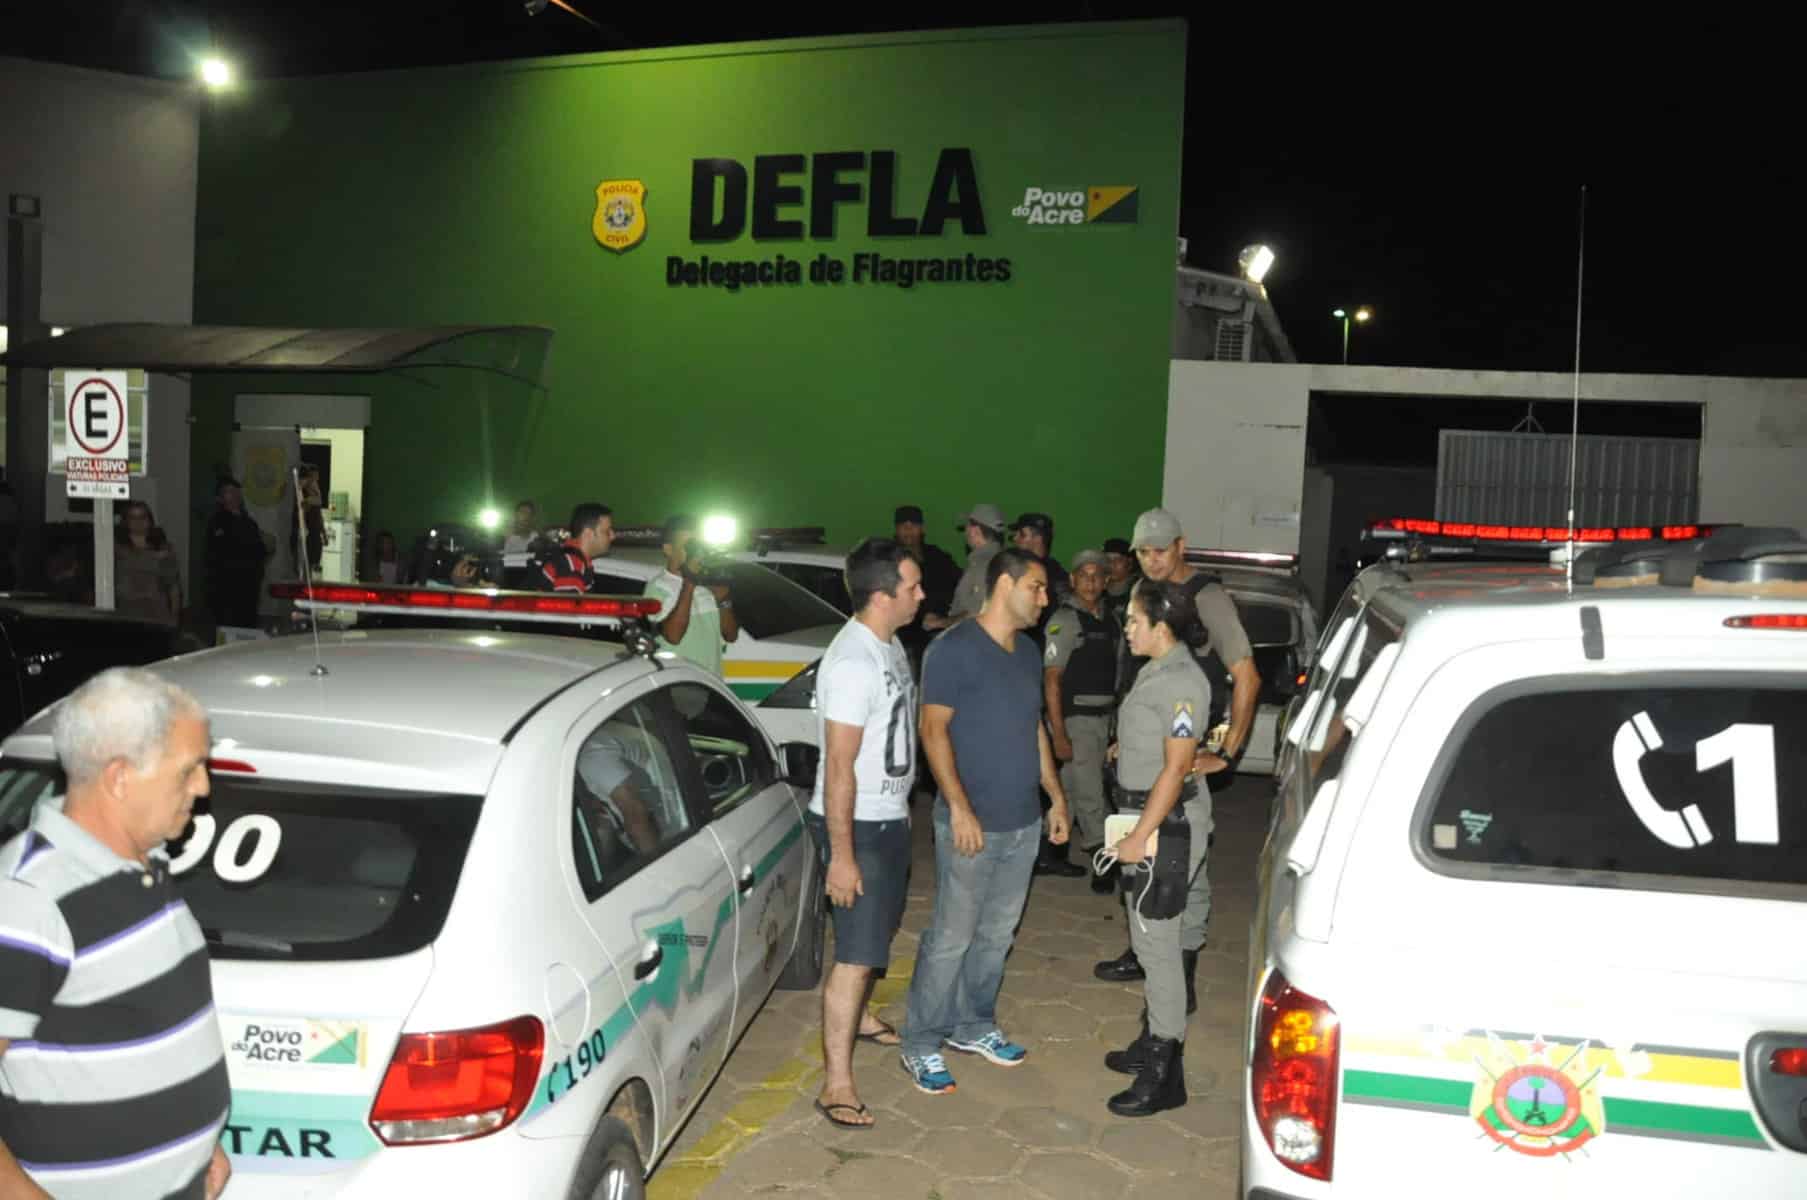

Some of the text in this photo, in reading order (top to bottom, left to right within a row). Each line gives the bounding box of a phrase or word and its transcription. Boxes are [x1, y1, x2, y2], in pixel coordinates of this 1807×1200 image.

[689, 148, 987, 242] DEFLA
[1024, 187, 1085, 208] Povo
[1012, 205, 1085, 225] do Acre
[666, 253, 1011, 292] Delegacia de Flagrantes
[85, 392, 108, 438] E
[68, 459, 127, 472] EXCLUSIVO
[1695, 722, 1780, 845] 1
[244, 1024, 302, 1045] Povo
[246, 1042, 302, 1062] Acre
[563, 1028, 606, 1091] 190
